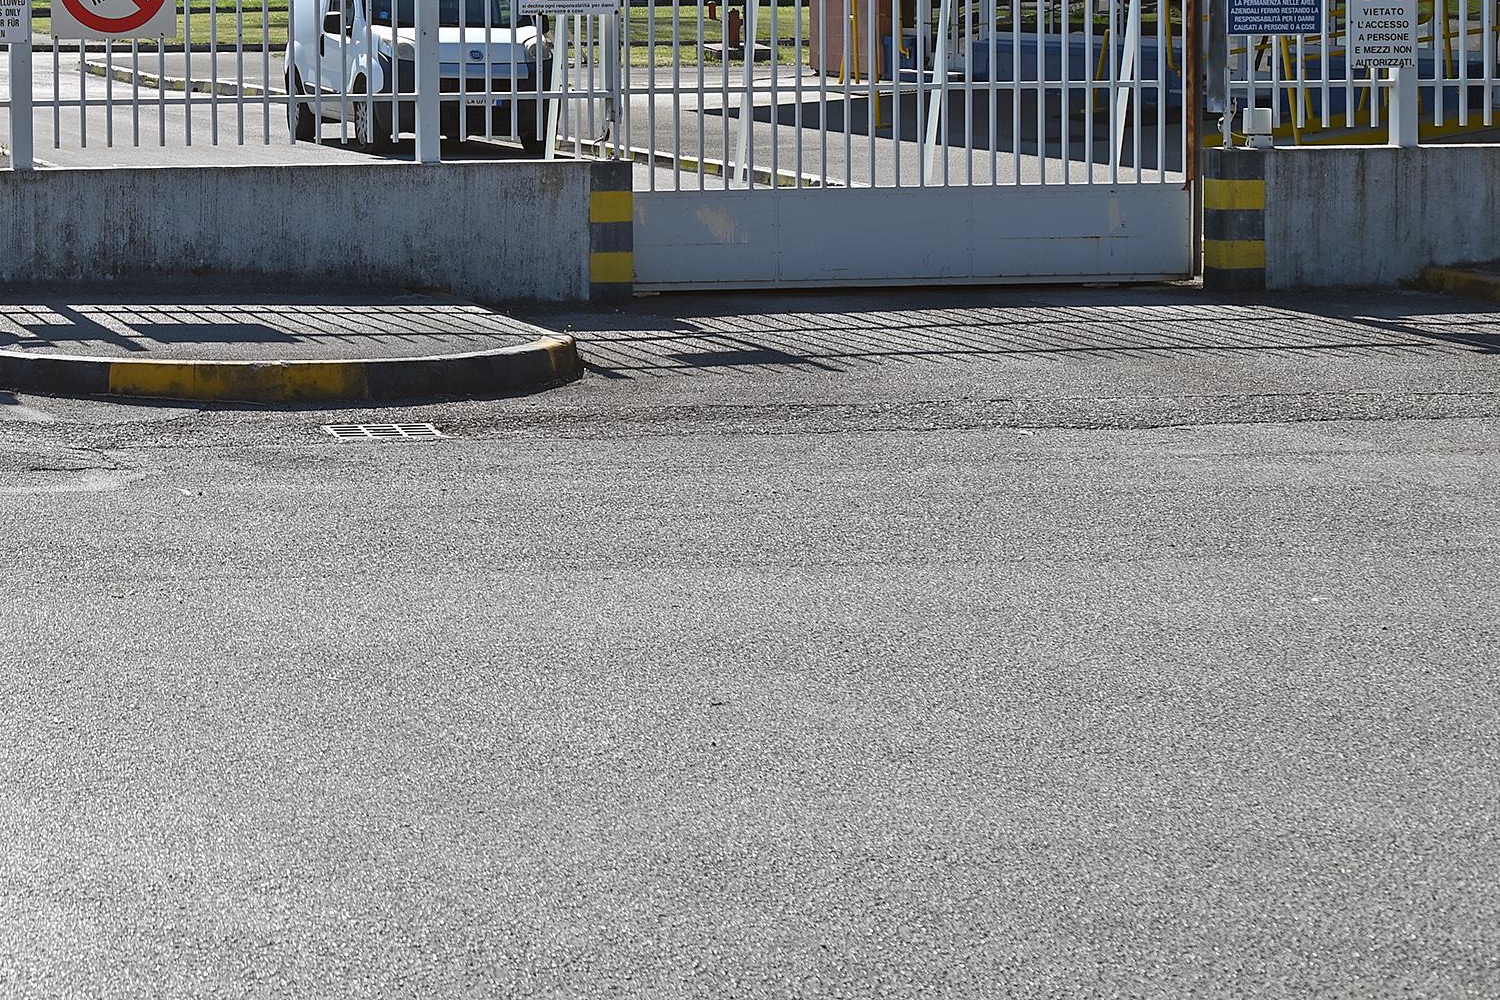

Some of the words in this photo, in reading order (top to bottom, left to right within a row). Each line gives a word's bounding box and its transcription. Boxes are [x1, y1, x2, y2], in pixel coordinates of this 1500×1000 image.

[8, 18, 20, 27] FÜR
[1367, 33, 1409, 41] PERSONE
[1355, 46, 1360, 54] E
